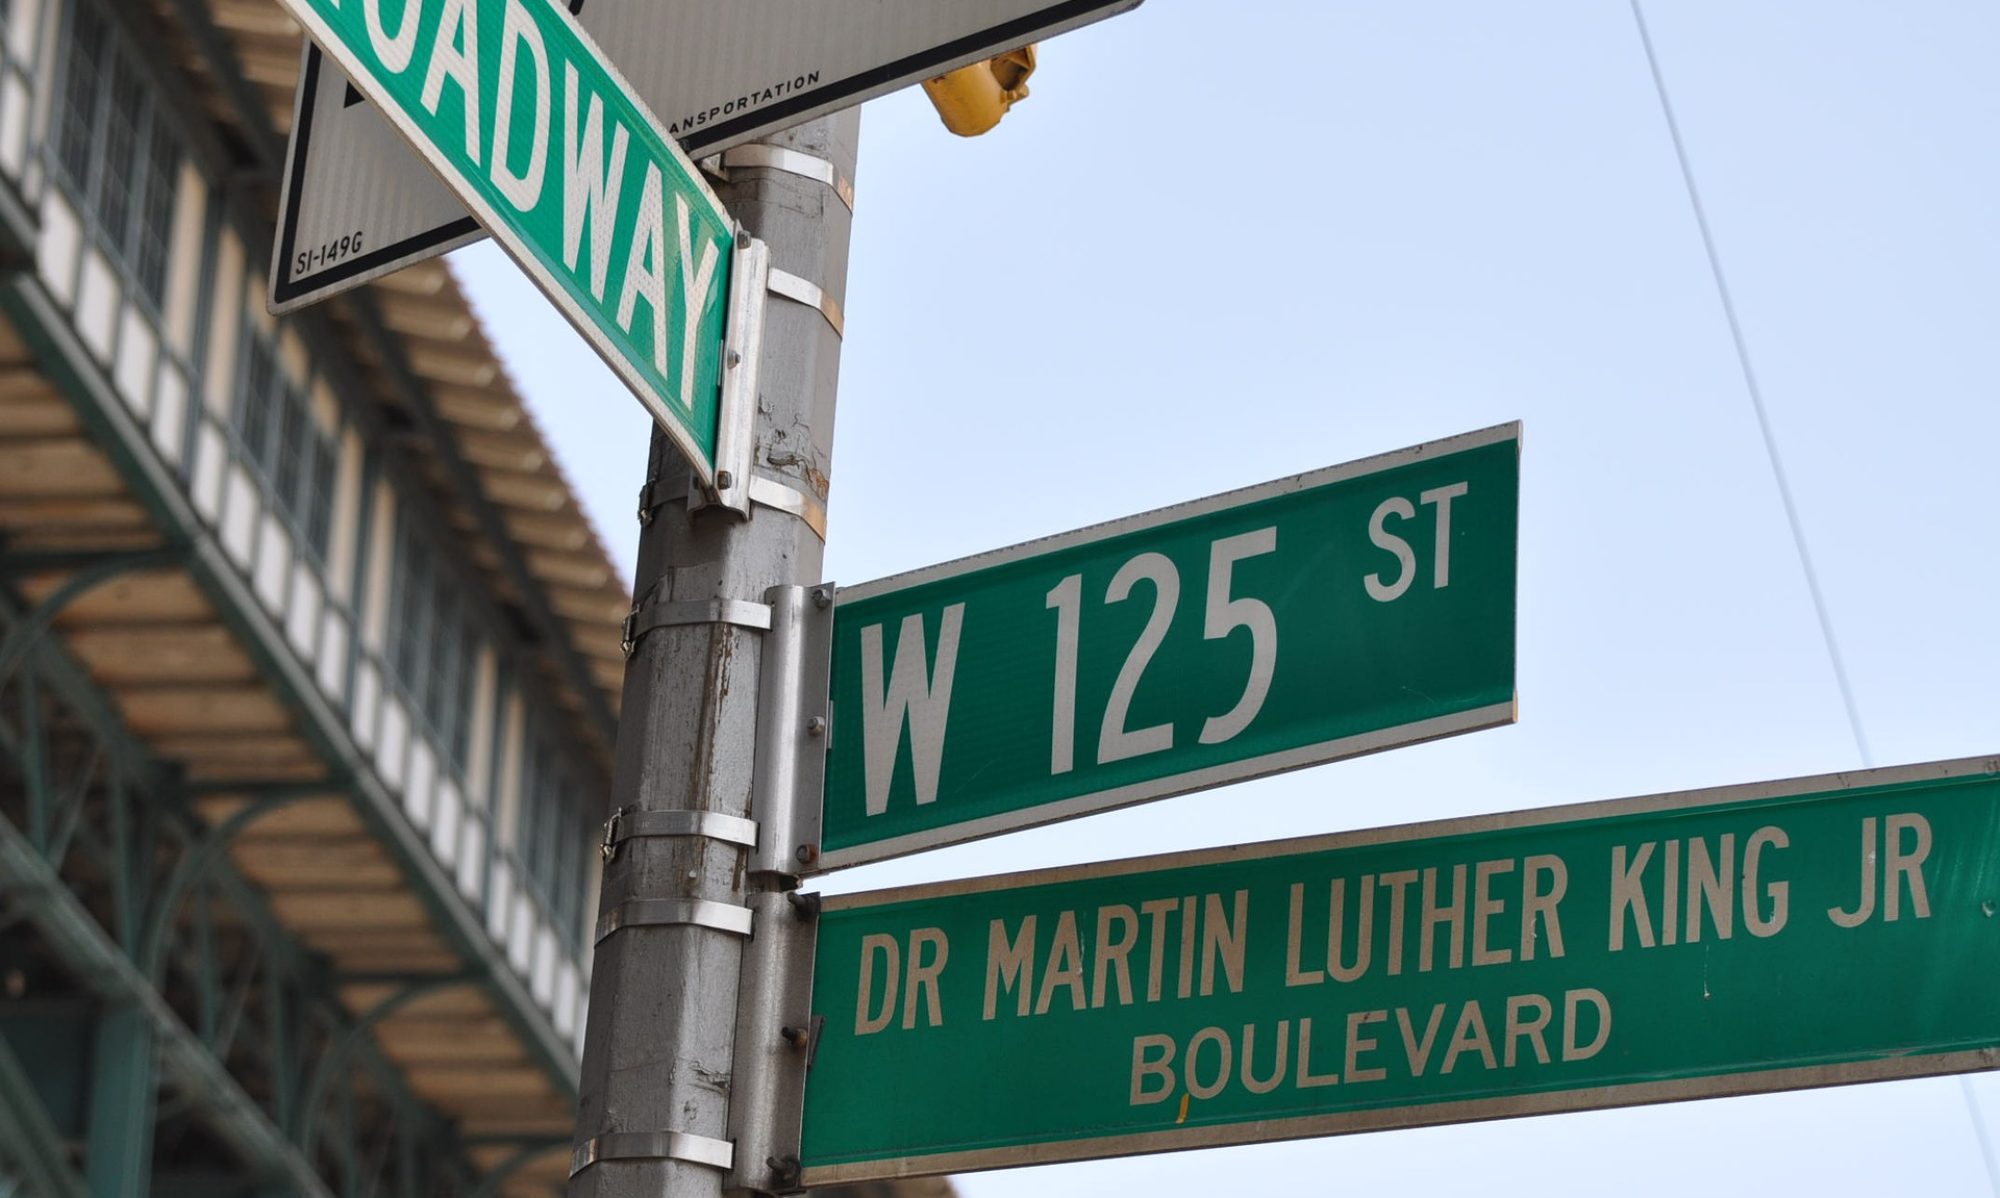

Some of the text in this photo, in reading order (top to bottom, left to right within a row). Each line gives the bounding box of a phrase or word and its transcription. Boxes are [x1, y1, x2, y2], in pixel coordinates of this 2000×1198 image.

[669, 70, 820, 134] ANSPORTATION
[295, 231, 363, 275] SI-149G
[310, 0, 720, 412] ADWAY
[861, 481, 1468, 817] W 125 ST
[854, 812, 1933, 1036] DR MARTIN LUTHER KING JR
[1129, 987, 1612, 1106] BOULEVARD
